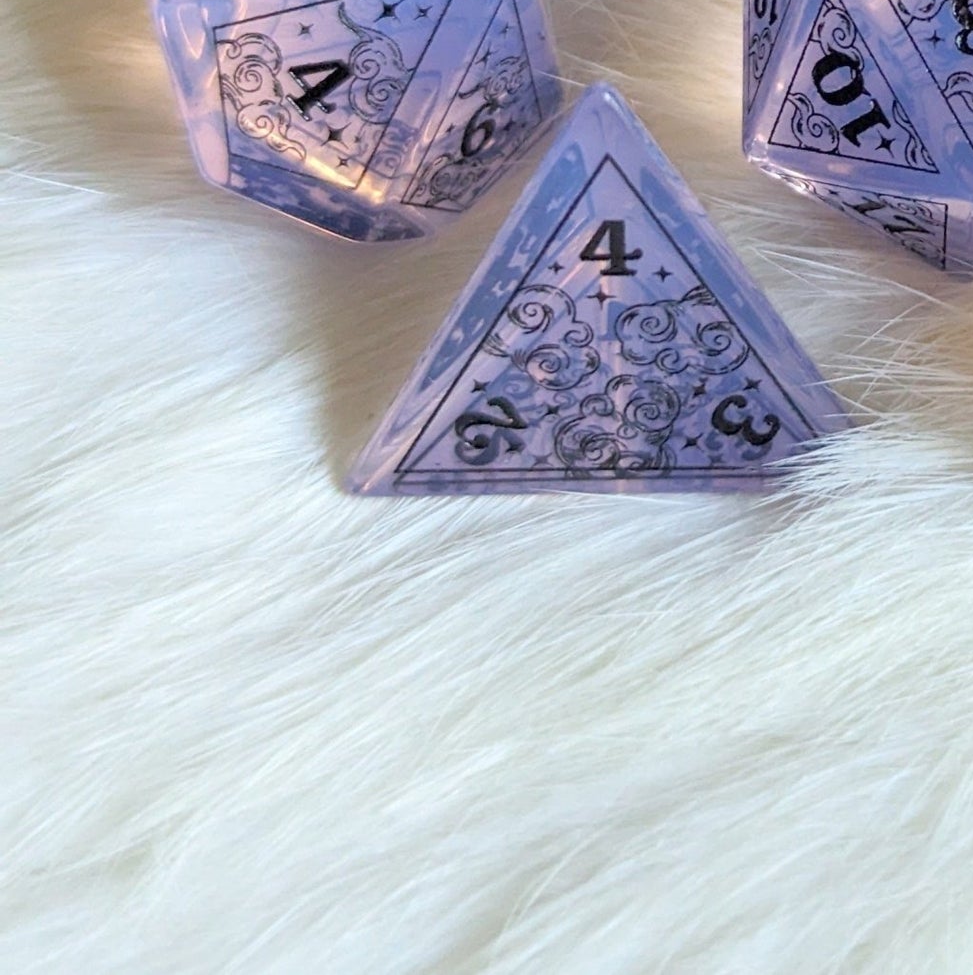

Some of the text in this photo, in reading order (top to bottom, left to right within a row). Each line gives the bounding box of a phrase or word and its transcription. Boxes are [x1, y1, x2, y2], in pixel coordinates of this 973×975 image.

[286, 58, 354, 121] 4
[810, 50, 893, 147] 10
[461, 101, 498, 158] 6
[579, 219, 643, 277] 4
[454, 395, 528, 450] 2
[711, 394, 781, 446] 3
